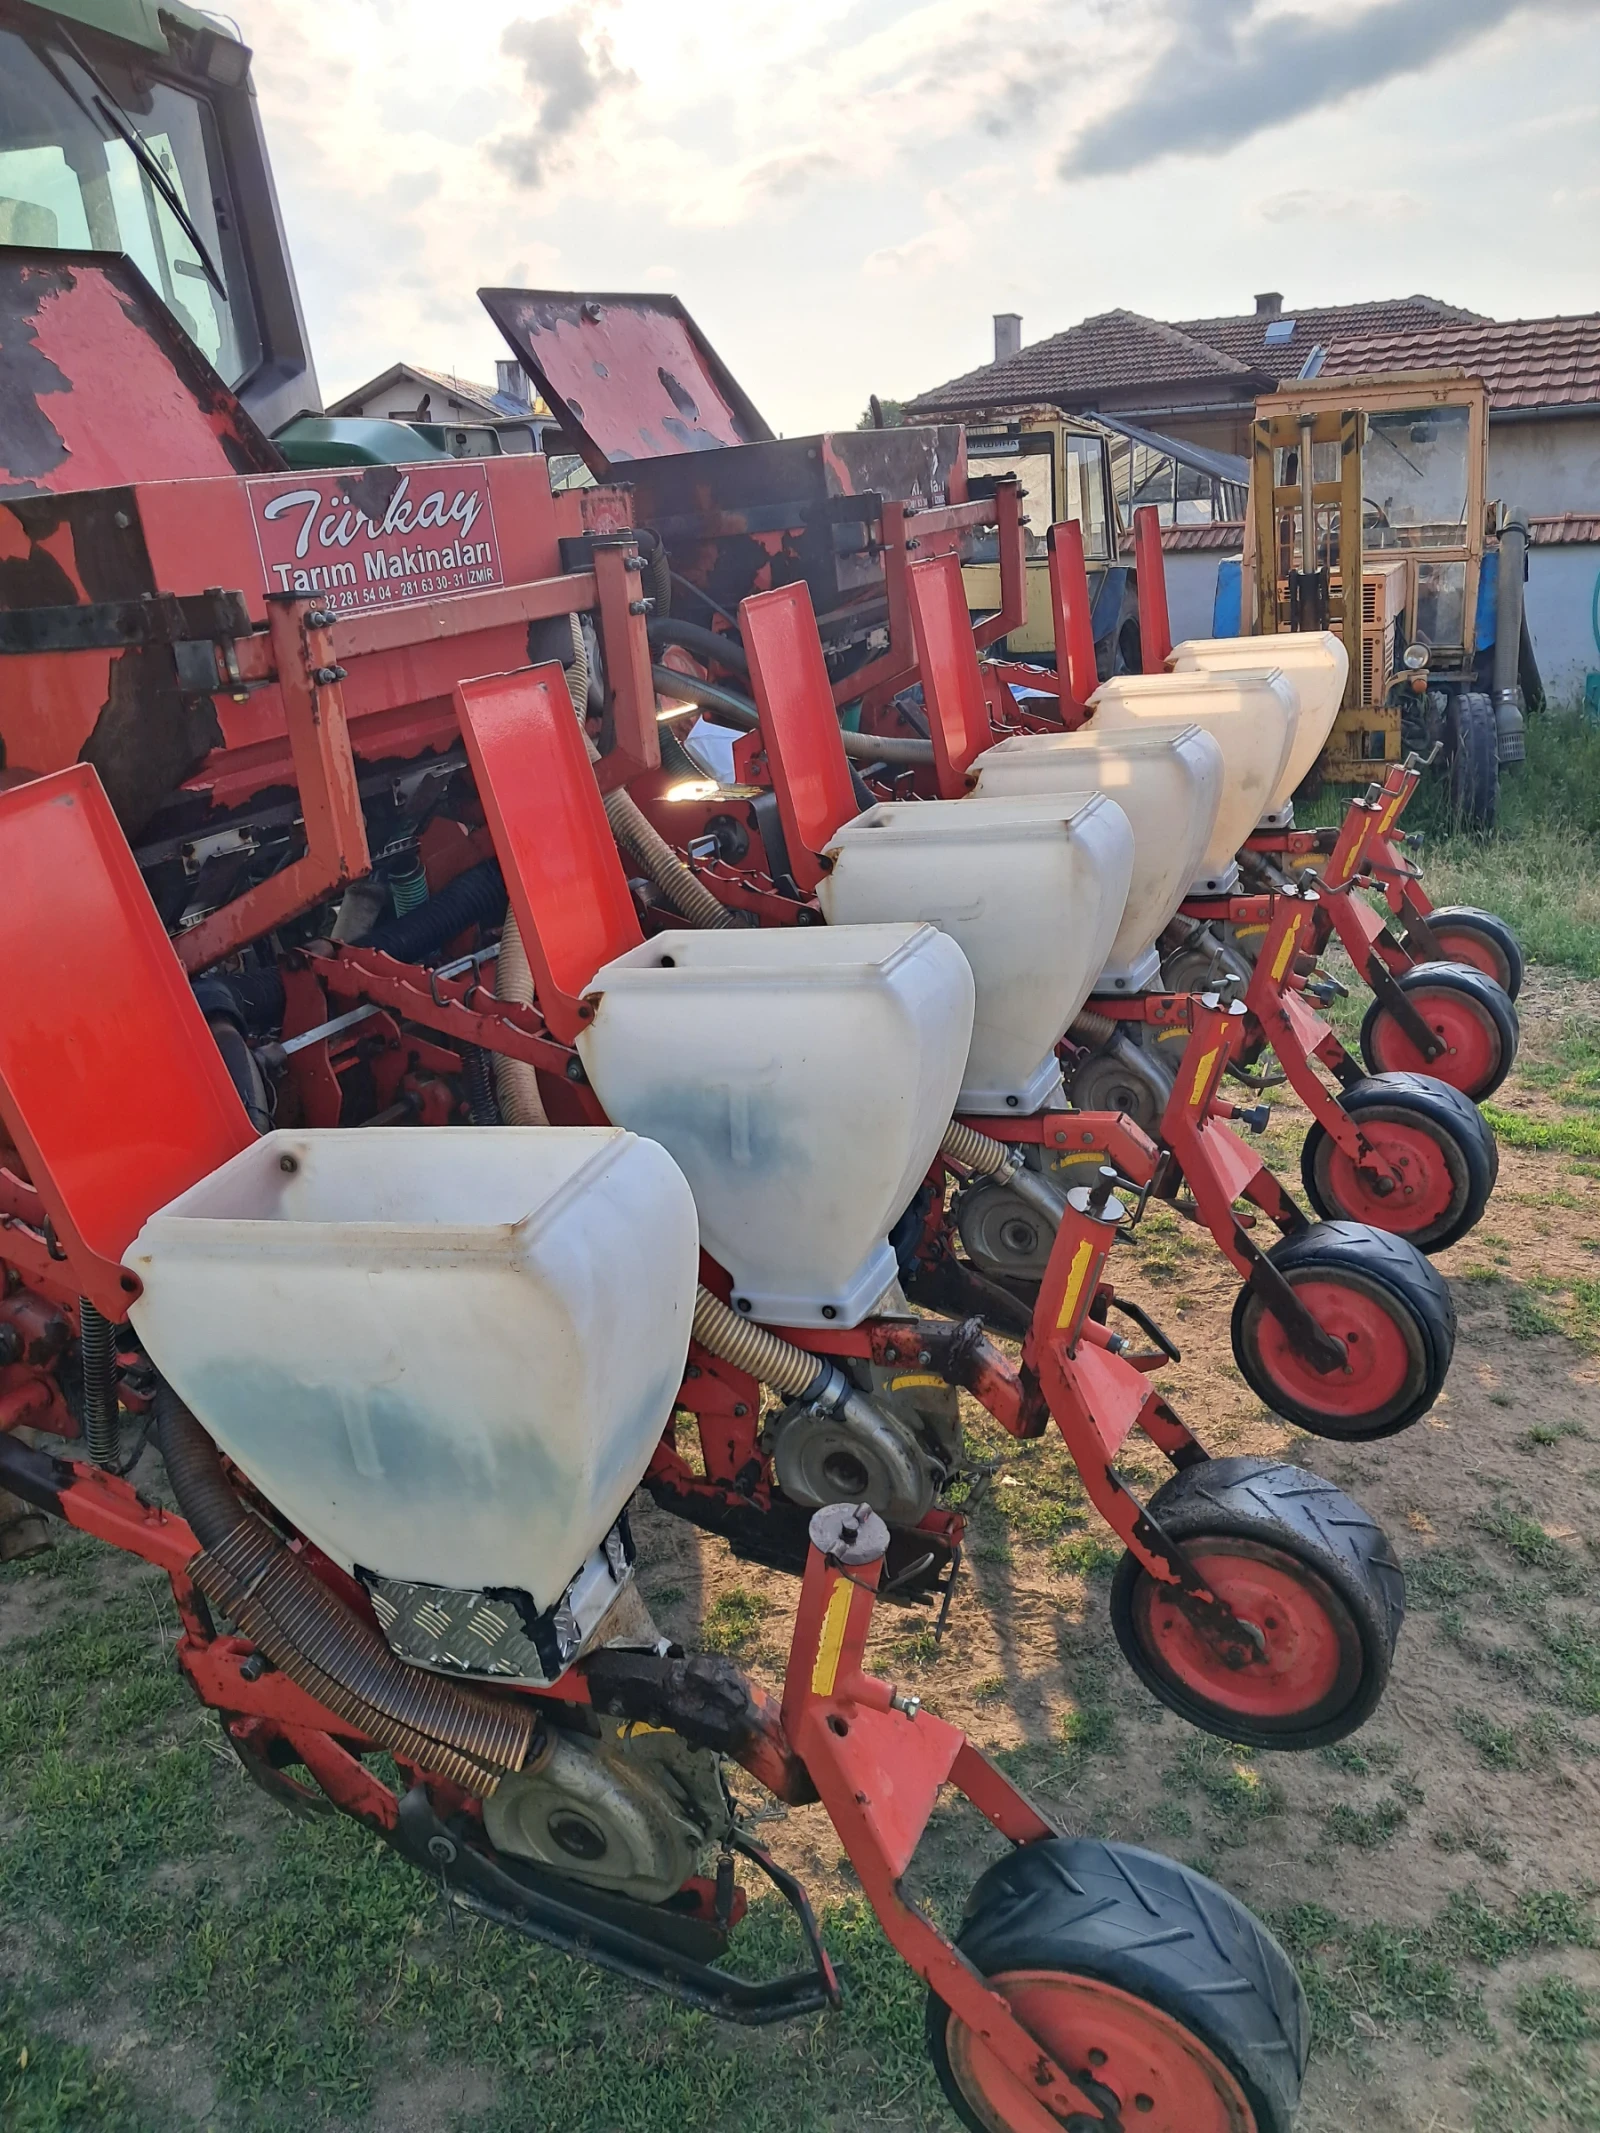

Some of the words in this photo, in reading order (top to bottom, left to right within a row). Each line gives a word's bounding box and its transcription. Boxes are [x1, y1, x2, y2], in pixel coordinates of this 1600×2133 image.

[264, 475, 483, 558] Türkay
[363, 539, 492, 581] Makinaları
[340, 590, 360, 607] 281
[363, 587, 376, 603] 54
[378, 585, 392, 601] 04
[400, 580, 419, 597] 281
[421, 578, 434, 593] 63
[453, 572, 465, 587] 31
